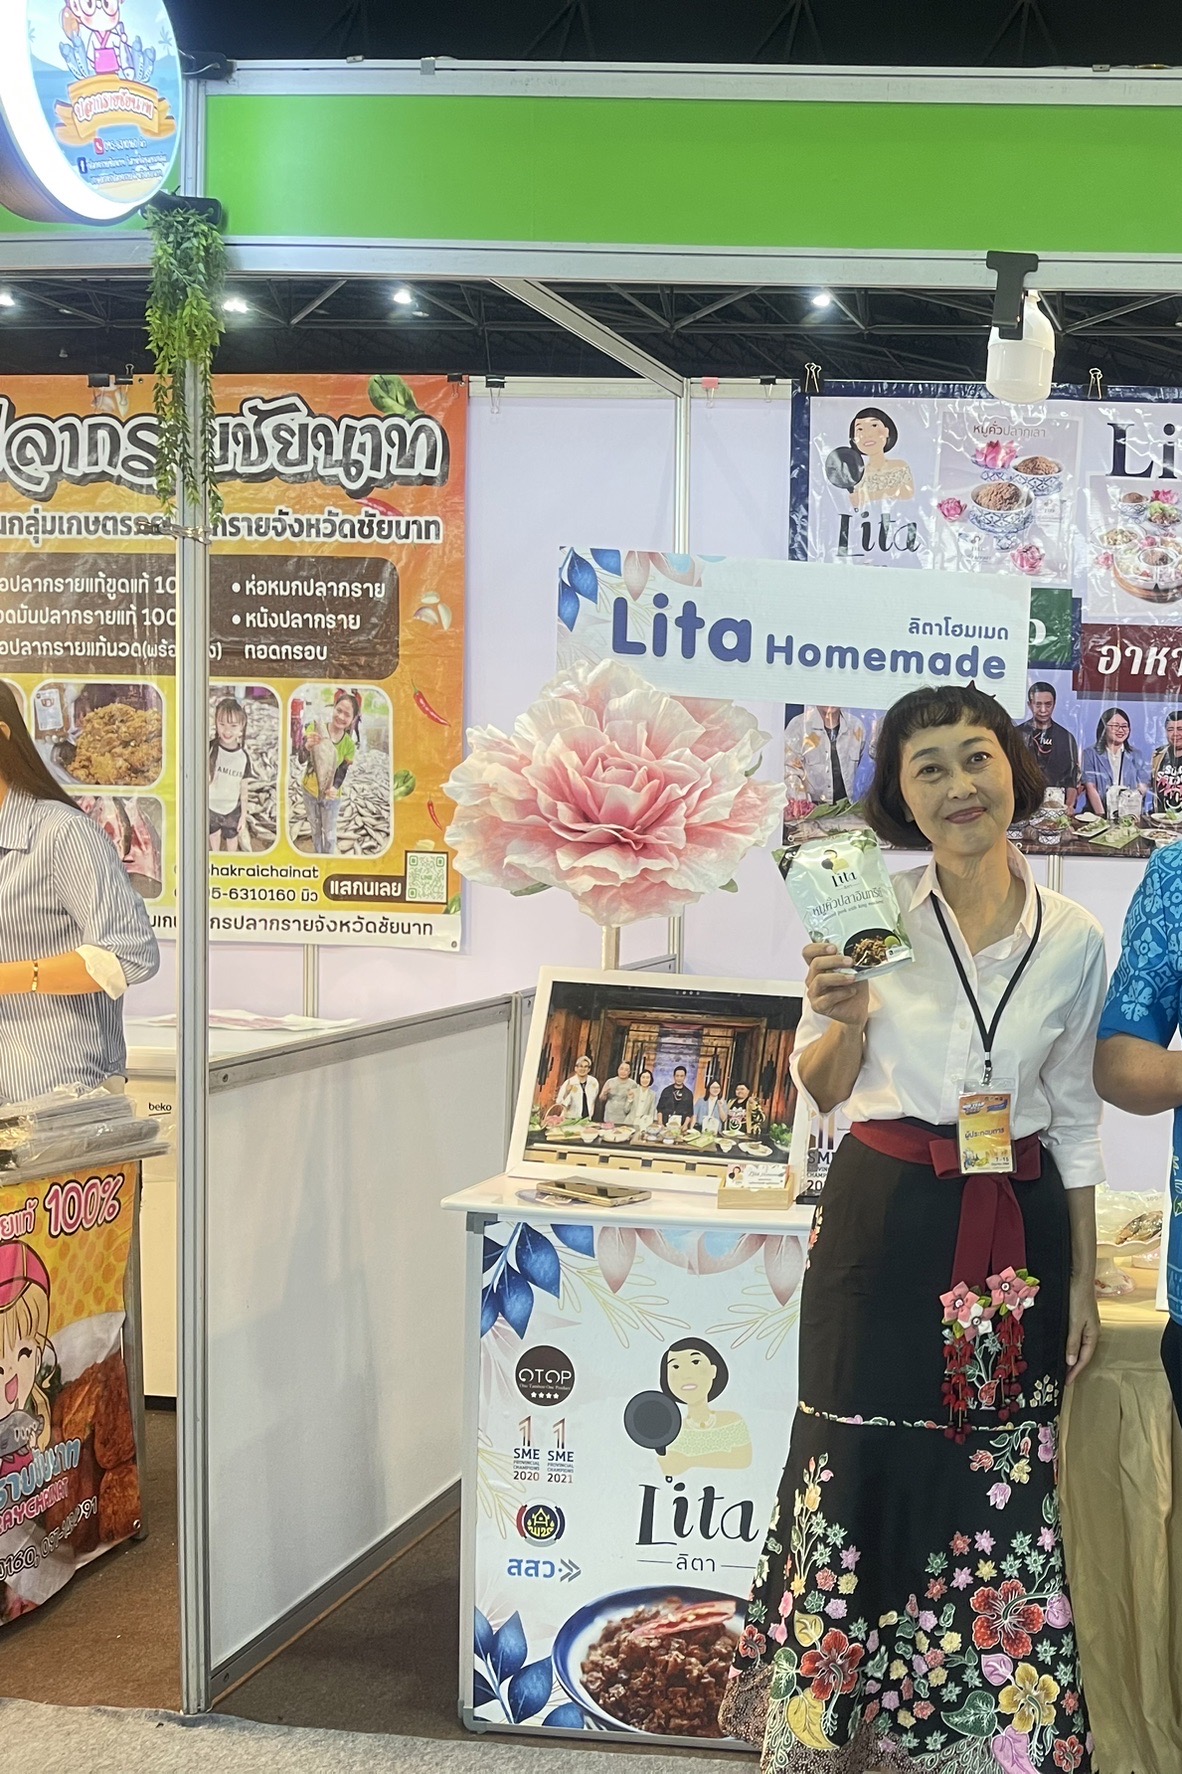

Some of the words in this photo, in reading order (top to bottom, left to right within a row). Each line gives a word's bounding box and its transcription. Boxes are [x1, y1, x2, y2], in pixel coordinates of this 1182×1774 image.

[837, 508, 921, 557] Lita
[245, 573, 386, 598] ห่อหมกปลากราย
[245, 607, 361, 630] หนังปลากราย
[908, 616, 1009, 640] ลิตาโฮมเมด
[612, 592, 753, 663] Lita
[766, 634, 1007, 679] Homemade
[245, 645, 328, 661] ทอดกรอบ
[831, 869, 858, 887] Lita
[330, 879, 402, 898] แสกนเลย
[149, 1102, 172, 1112] beko
[46, 1174, 125, 1236] 100%
[518, 1368, 572, 1384] OTOP
[514, 1448, 540, 1460] SME
[548, 1450, 574, 1462] SME
[514, 1471, 540, 1481] 2020
[547, 1473, 573, 1483] 2021
[635, 1475, 760, 1547] Lita
[507, 1558, 555, 1578] สสว
[676, 1553, 716, 1572] ลิตา
